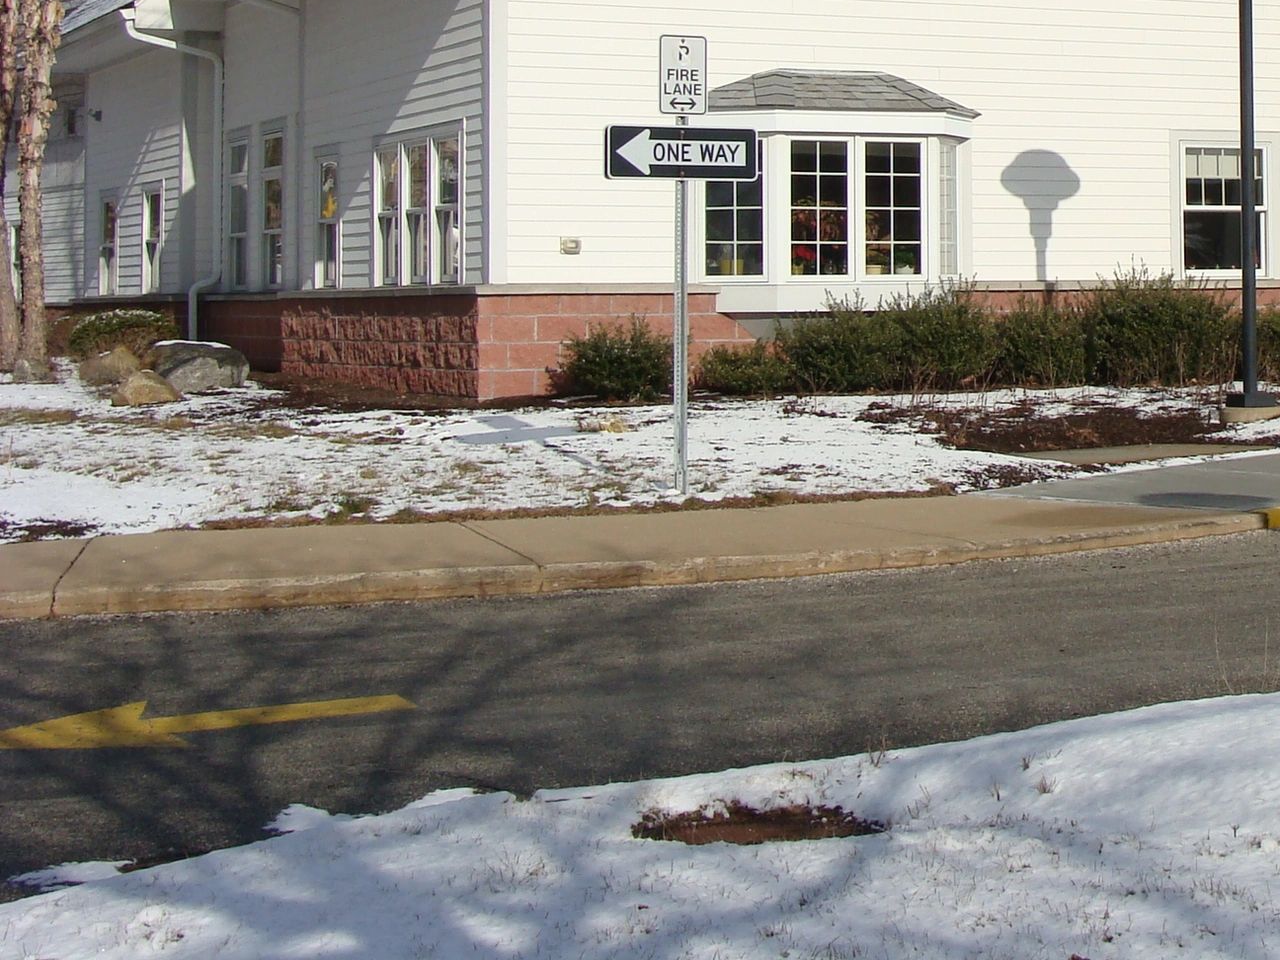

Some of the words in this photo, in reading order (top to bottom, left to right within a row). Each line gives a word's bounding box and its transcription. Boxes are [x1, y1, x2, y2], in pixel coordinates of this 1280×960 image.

[667, 68, 700, 82] FIRE
[663, 83, 702, 96] LANE
[653, 143, 692, 163] ONE
[700, 144, 740, 163] WAY
